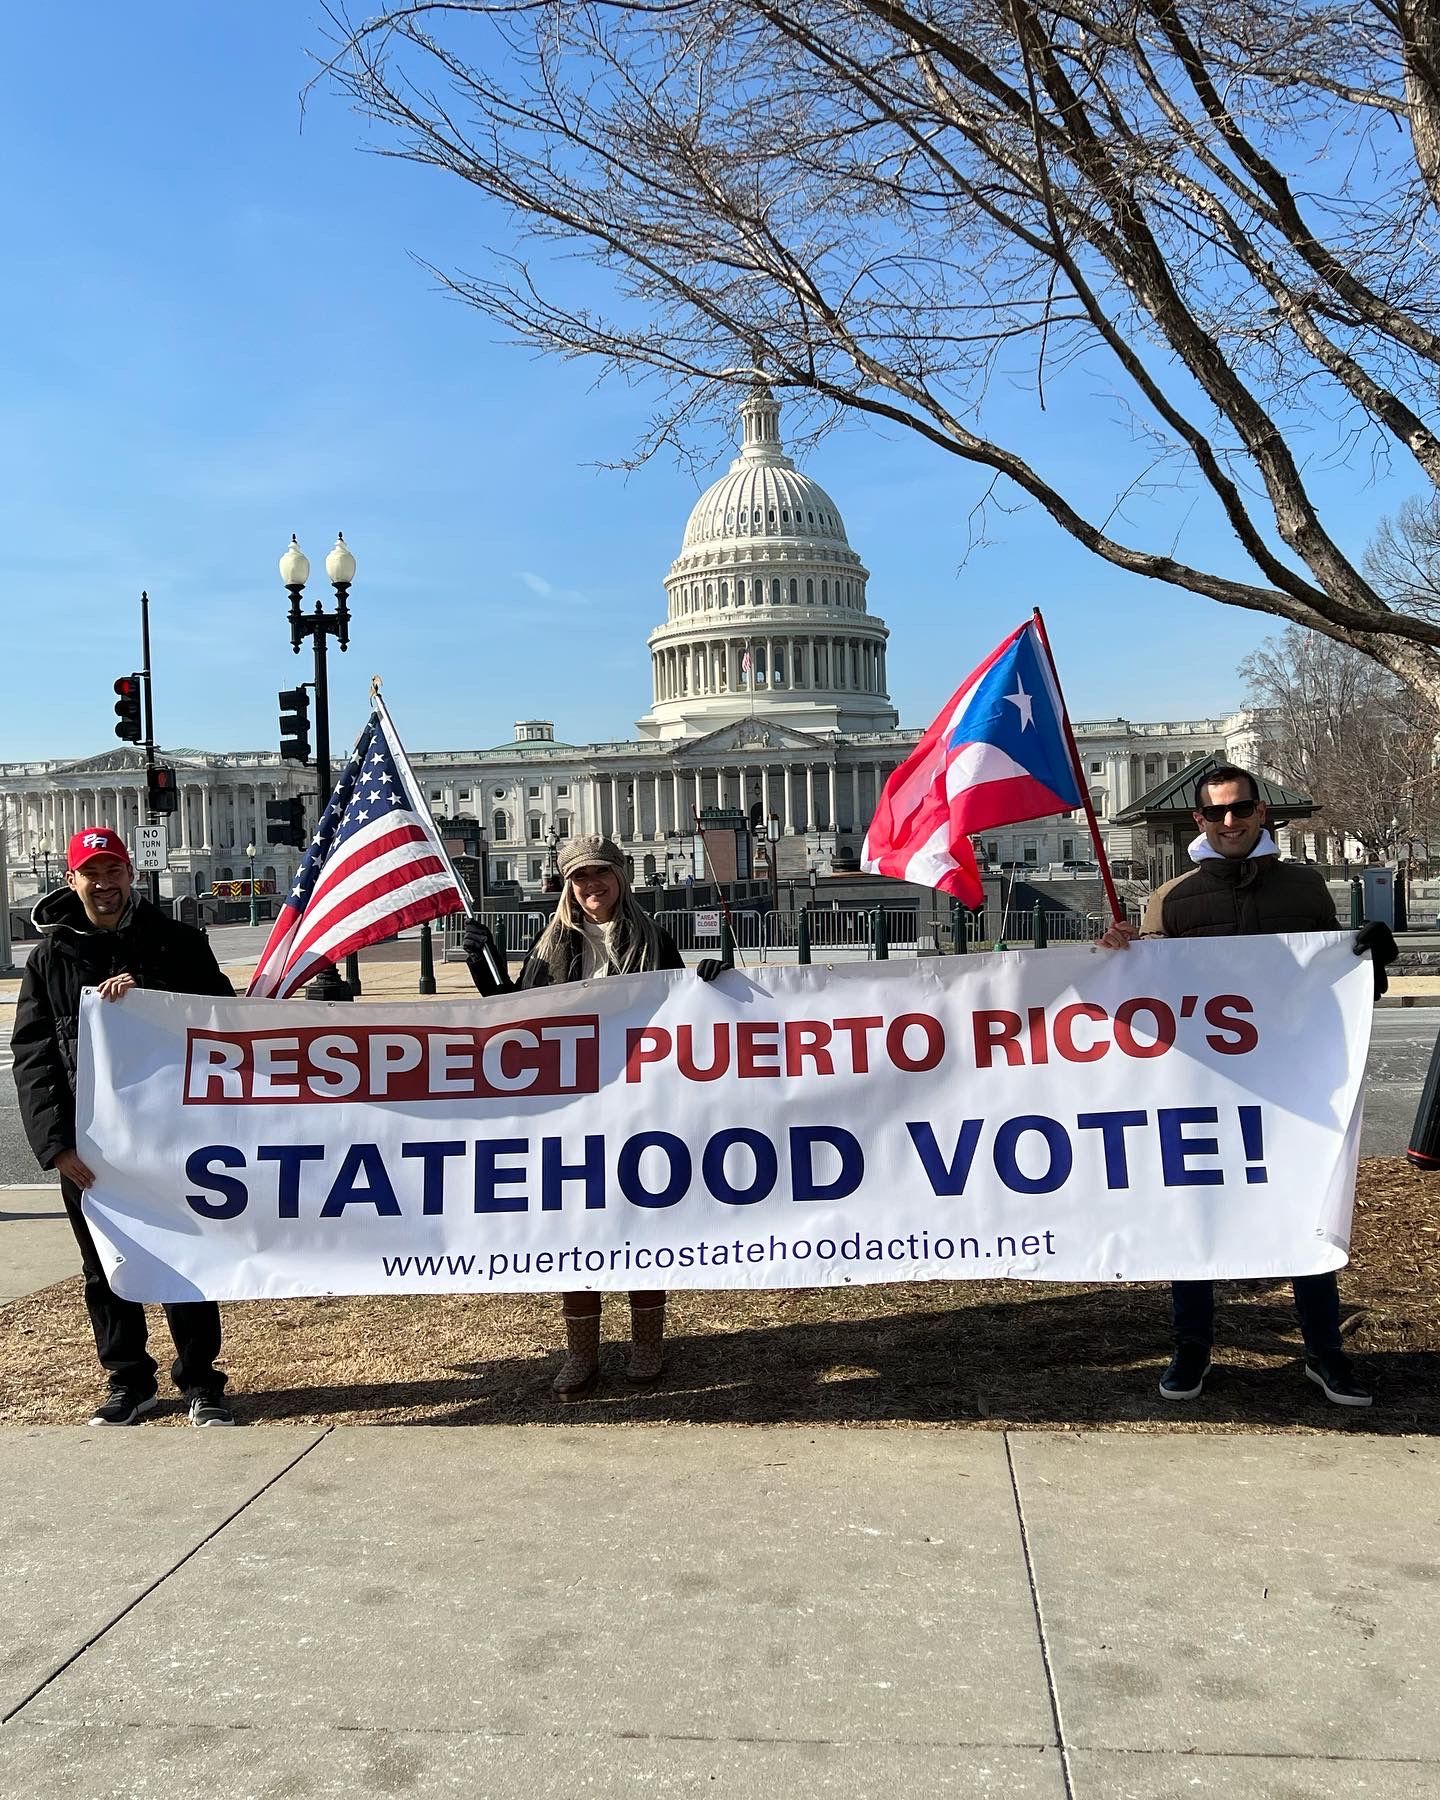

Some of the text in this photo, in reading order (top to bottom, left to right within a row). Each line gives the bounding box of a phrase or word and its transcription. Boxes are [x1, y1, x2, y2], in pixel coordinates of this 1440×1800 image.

[143, 829, 158, 838] NO
[141, 840, 161, 848] TURN
[145, 850, 157, 858] ON
[144, 859, 159, 867] RED
[188, 994, 1259, 1098] RESPECT PUERTO RICO'S
[185, 1105, 1269, 1220] STATEHOOD VOTE!
[381, 1229, 1057, 1281] www.puertoricostatehoodaction.net
